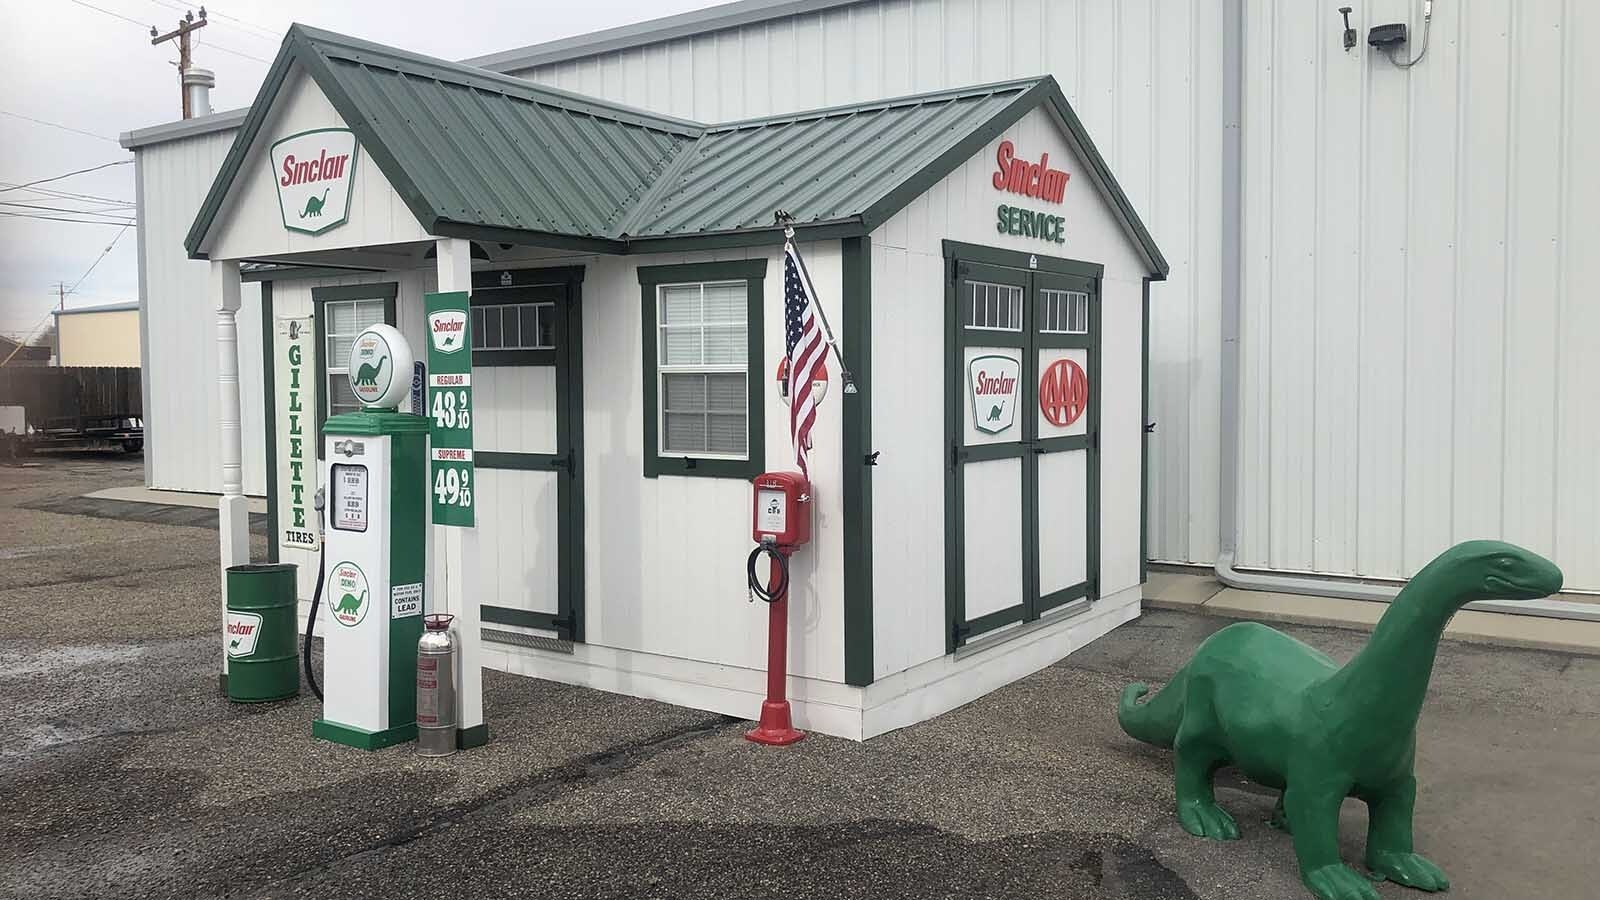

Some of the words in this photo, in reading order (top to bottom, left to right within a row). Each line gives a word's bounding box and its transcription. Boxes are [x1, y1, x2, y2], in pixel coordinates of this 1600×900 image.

[281, 149, 349, 187] Sinclair
[993, 140, 1071, 204] Sinclair
[996, 204, 1066, 243] SERVICE
[433, 318, 464, 333] Sinclair
[437, 375, 463, 385] REGULAR
[976, 370, 1015, 395] Sinclair
[1041, 360, 1087, 426] AAA
[288, 345, 305, 528] GILLETTE
[438, 449, 466, 460] SUPREME
[285, 530, 314, 544] TIRES
[394, 595, 419, 604] CONTAINS
[398, 603, 416, 612] LEAD
[227, 621, 255, 635] nclair
